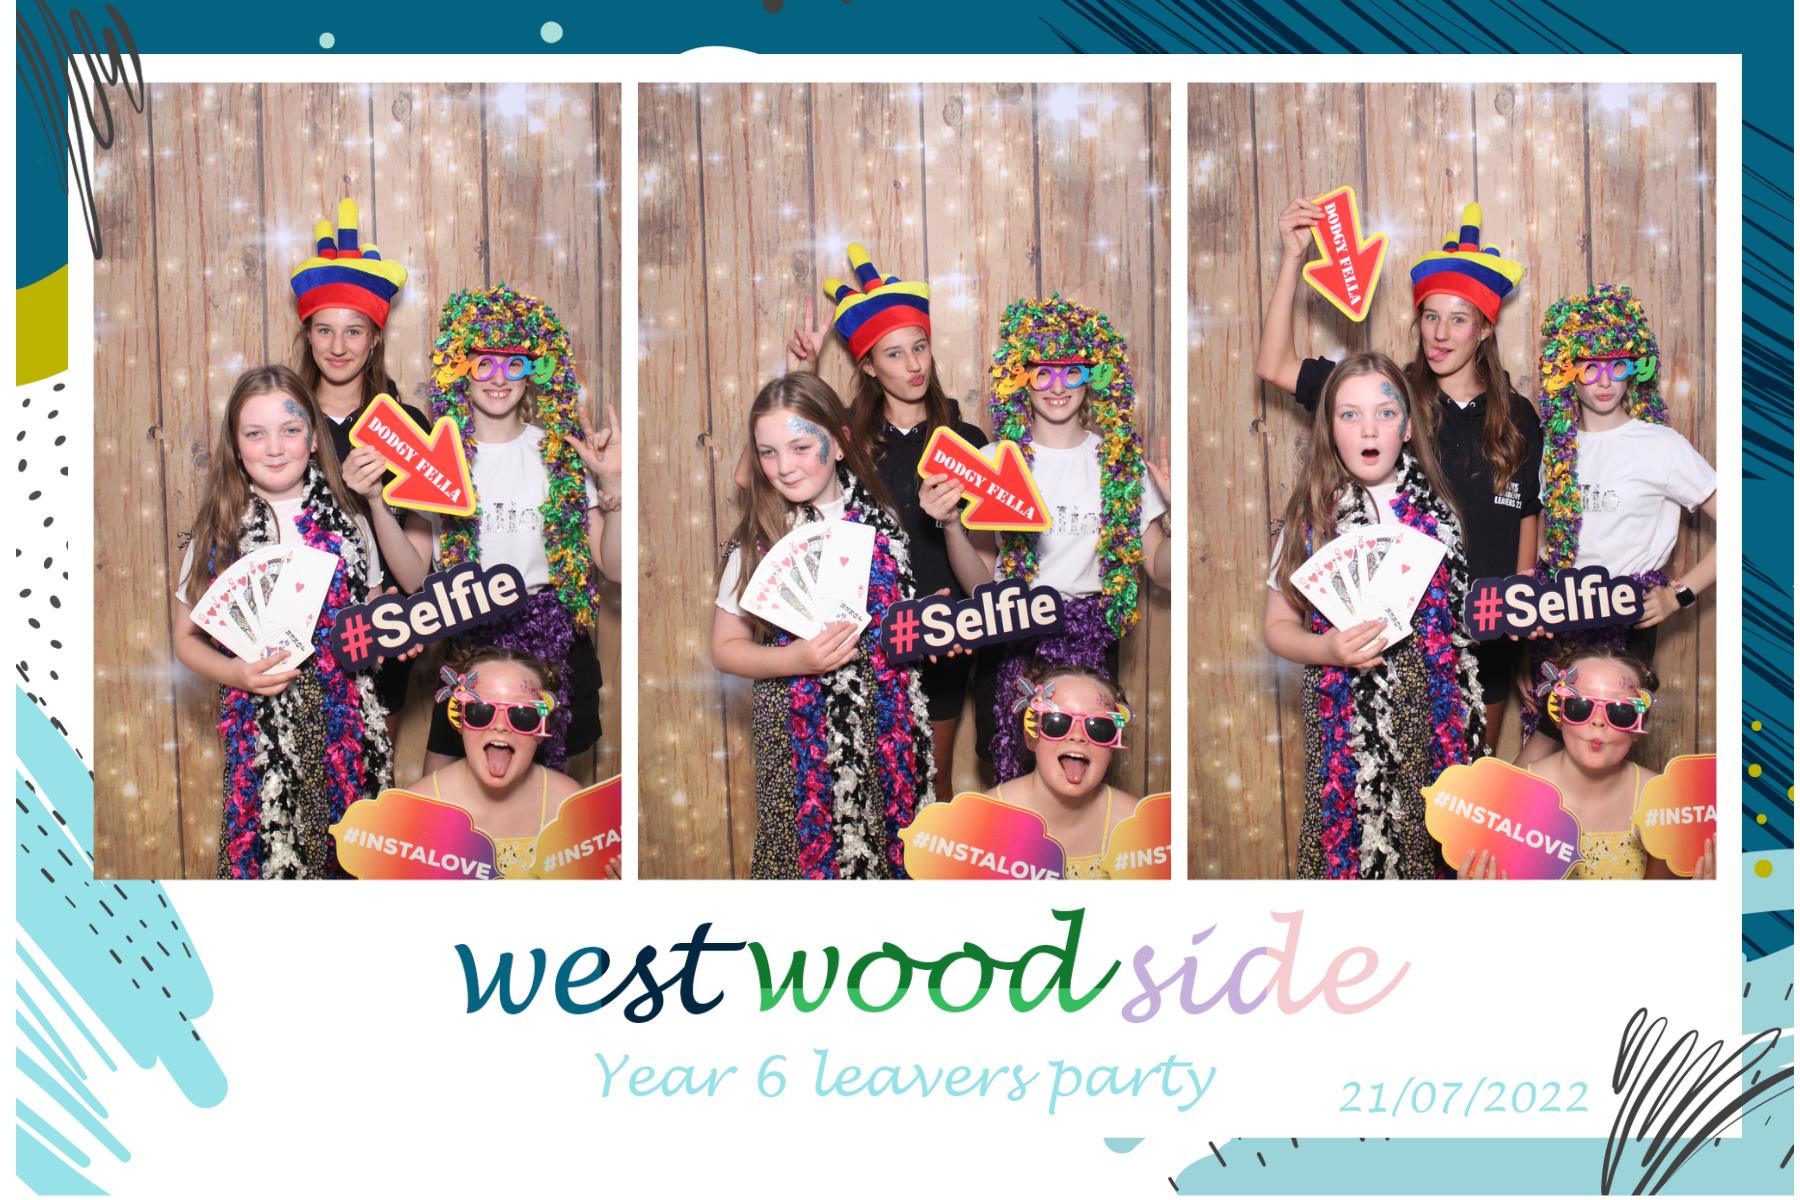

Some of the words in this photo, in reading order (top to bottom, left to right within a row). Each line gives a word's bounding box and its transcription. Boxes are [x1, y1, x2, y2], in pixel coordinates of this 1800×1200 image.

[1324, 201, 1349, 254] DODGY
[1339, 255, 1362, 306] FELLA
[367, 416, 418, 462] DODGY
[415, 457, 463, 504] FELLA
[933, 448, 987, 488] DODGY
[986, 481, 1036, 521] FELLA
[340, 570, 520, 663] #Selfie
[889, 586, 1058, 655] #Selfie
[1473, 574, 1637, 632] #Selfie
[543, 825, 622, 873] #INSTA
[1434, 790, 1575, 863] #INSTALOVE
[1644, 804, 1717, 828] #INSTA
[343, 826, 492, 880] #INSTALOVE
